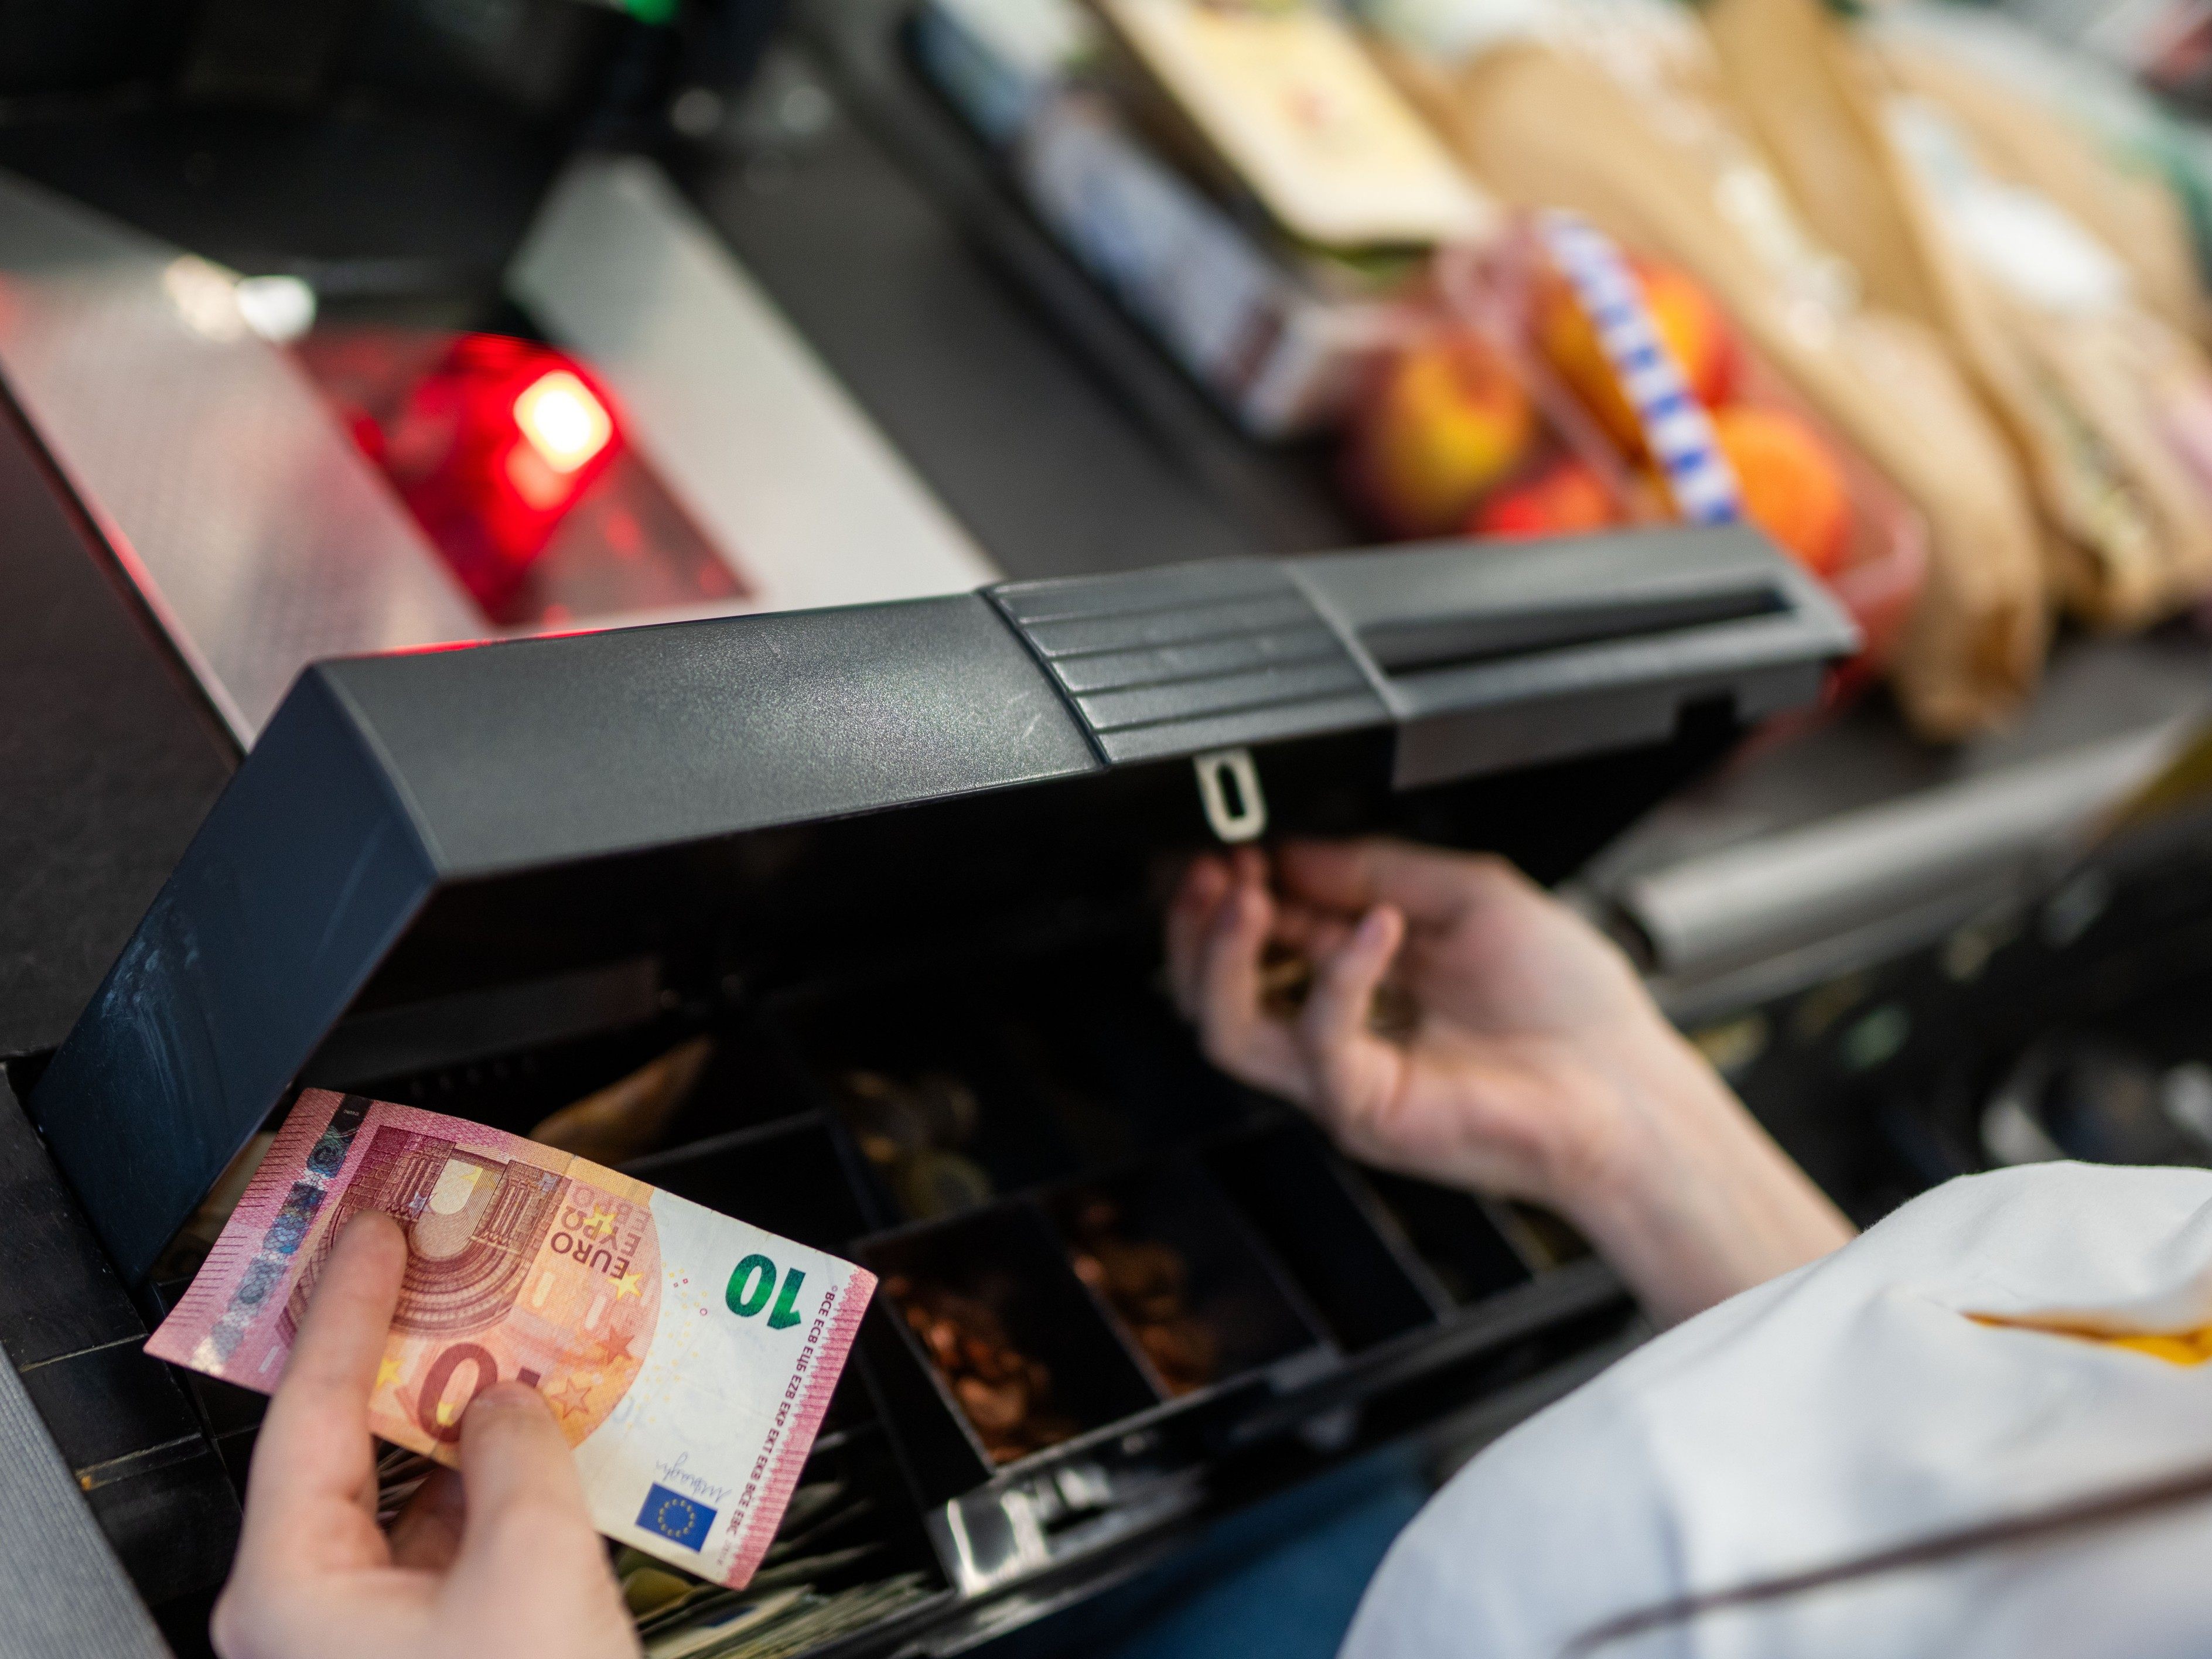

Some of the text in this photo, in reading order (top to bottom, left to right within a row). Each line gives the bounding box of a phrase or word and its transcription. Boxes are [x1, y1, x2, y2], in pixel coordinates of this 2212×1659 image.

[551, 1231, 630, 1279] EURO
[725, 1254, 806, 1330] 10
[807, 1319, 825, 1344] ECB
[785, 1374, 802, 1400] EZB
[775, 1401, 791, 1426] EKP
[750, 1455, 768, 1480] EKB
